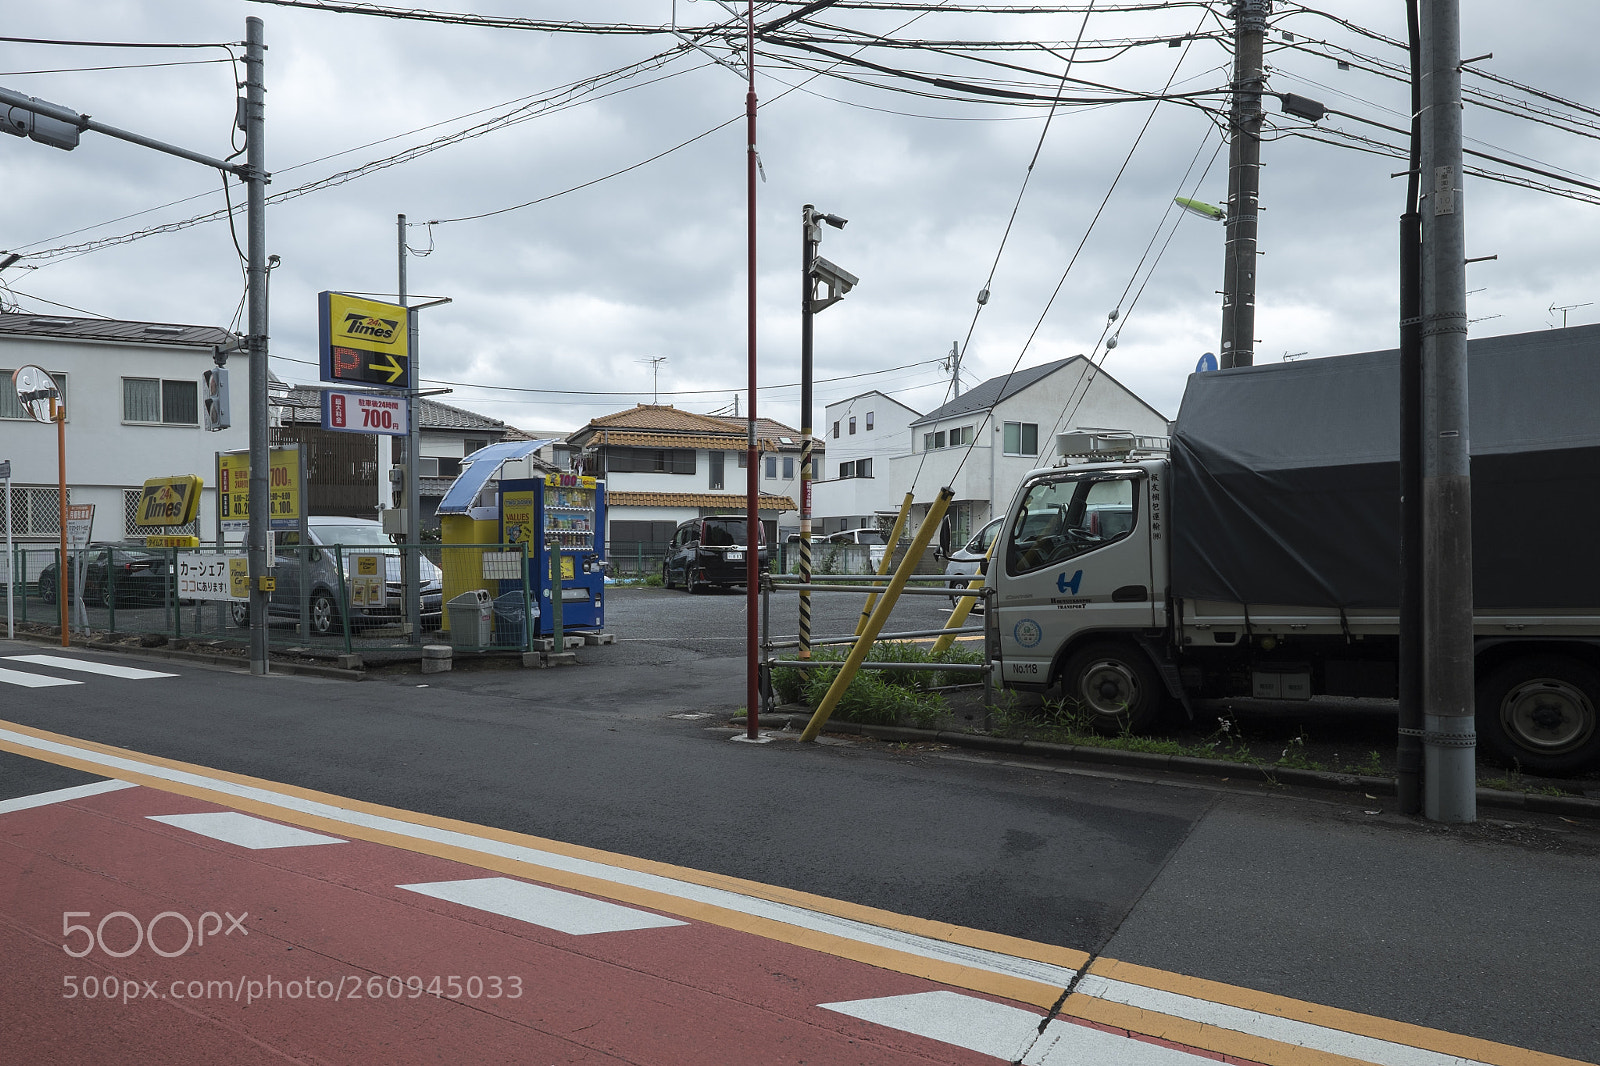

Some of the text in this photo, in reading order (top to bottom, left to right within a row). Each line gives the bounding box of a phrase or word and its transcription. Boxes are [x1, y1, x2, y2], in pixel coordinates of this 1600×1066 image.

[344, 316, 394, 338] Times
[334, 346, 360, 377] P
[143, 495, 182, 520] Times
[180, 561, 225, 577] カーシェア
[181, 580, 228, 594] ココにあります!
[1012, 663, 1038, 674] No.118
